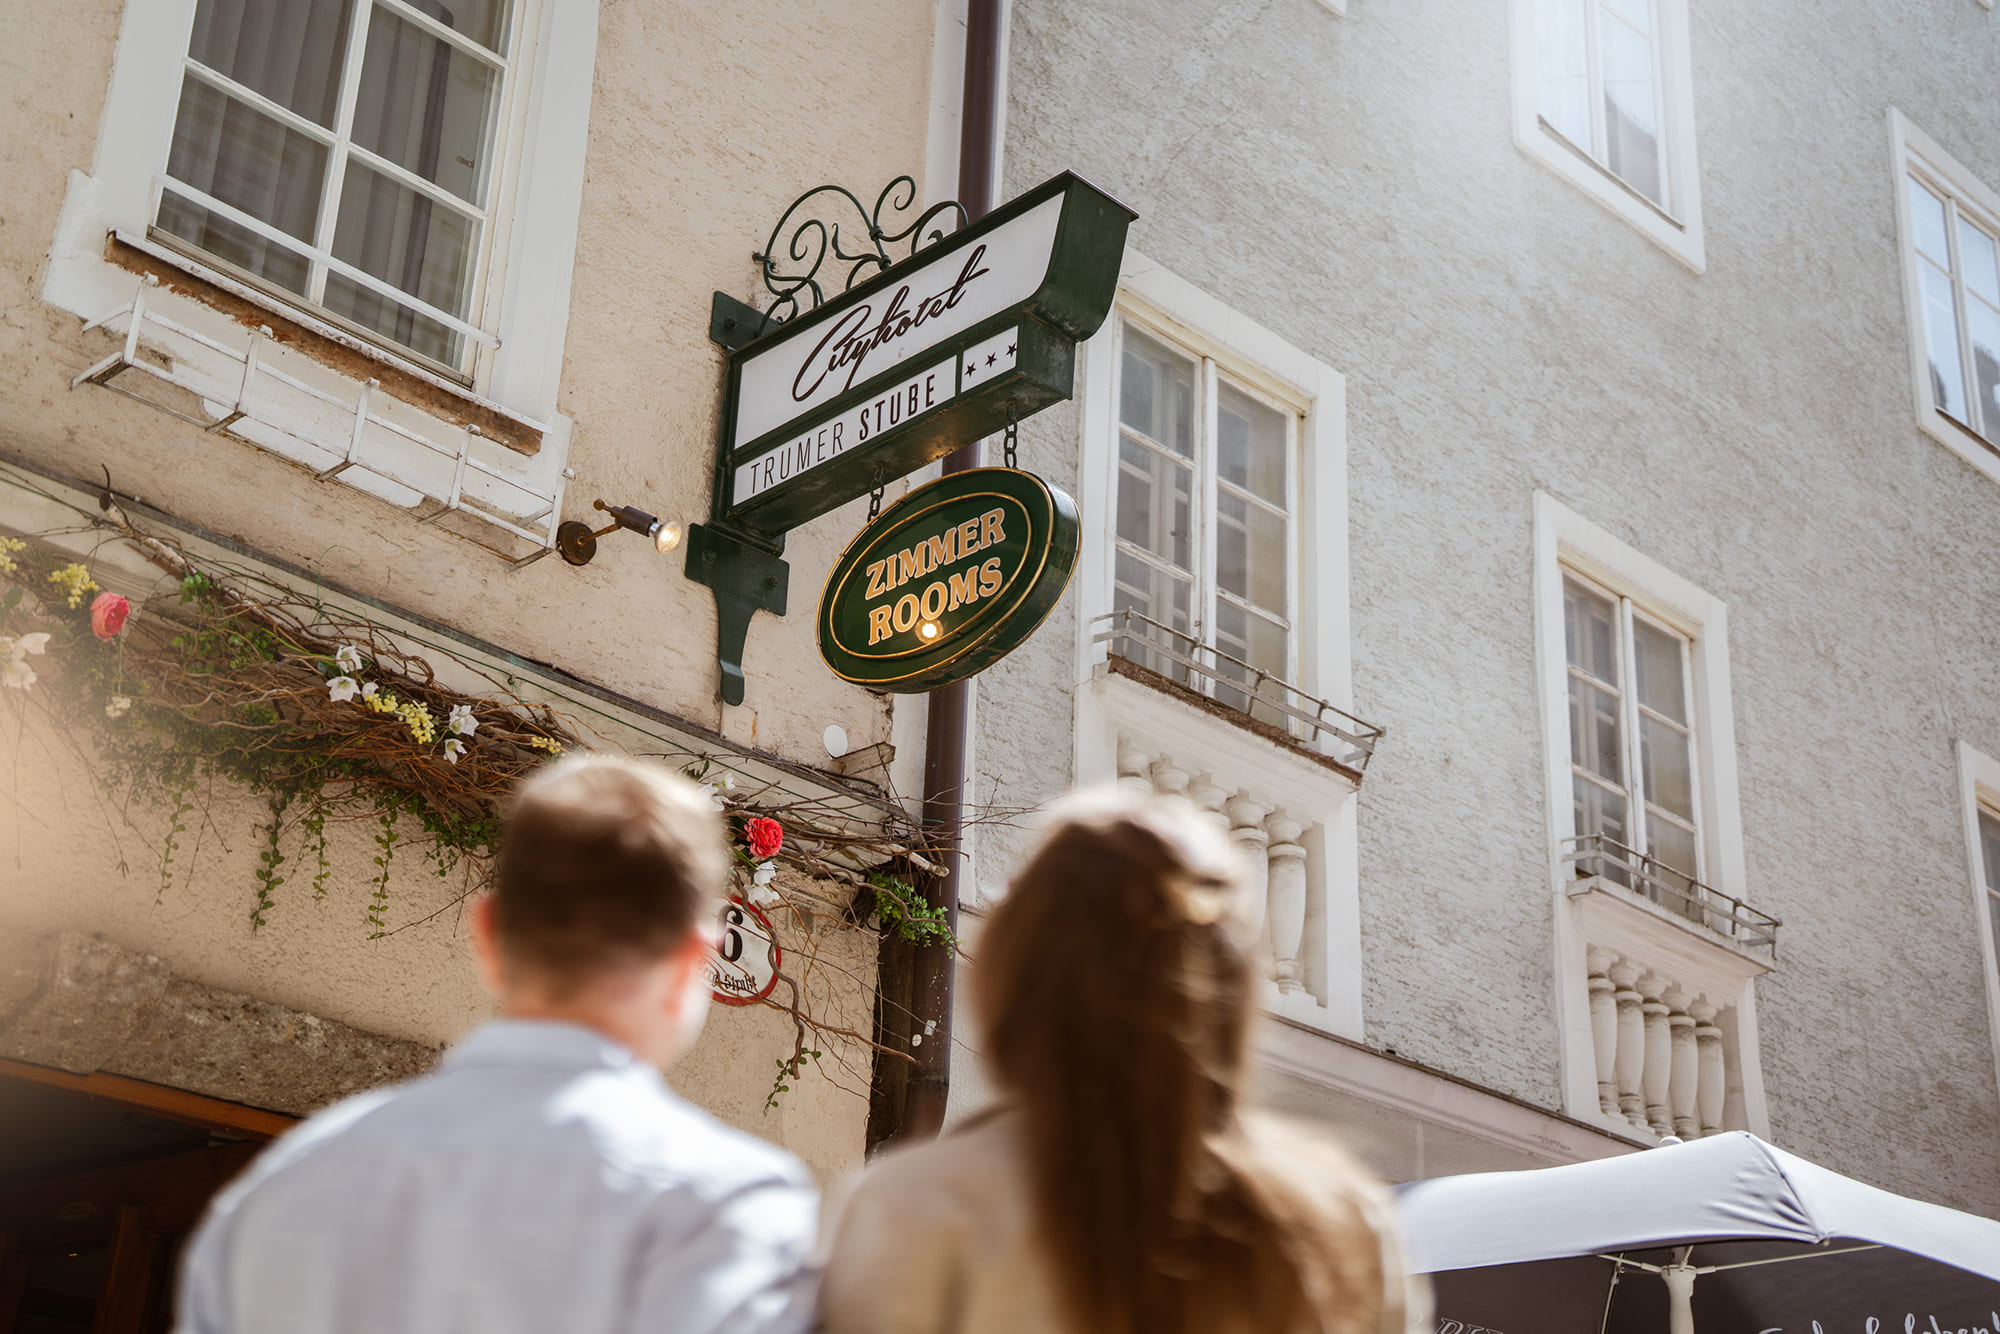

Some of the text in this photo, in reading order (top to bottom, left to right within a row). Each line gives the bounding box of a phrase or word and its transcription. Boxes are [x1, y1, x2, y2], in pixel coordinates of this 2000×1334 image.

[791, 244, 990, 402] Cityhotel
[750, 374, 936, 494] TRUMER STUBE
[865, 507, 1006, 600] ZIMMER
[868, 557, 1003, 646] ROOMS
[716, 905, 743, 962] 6
